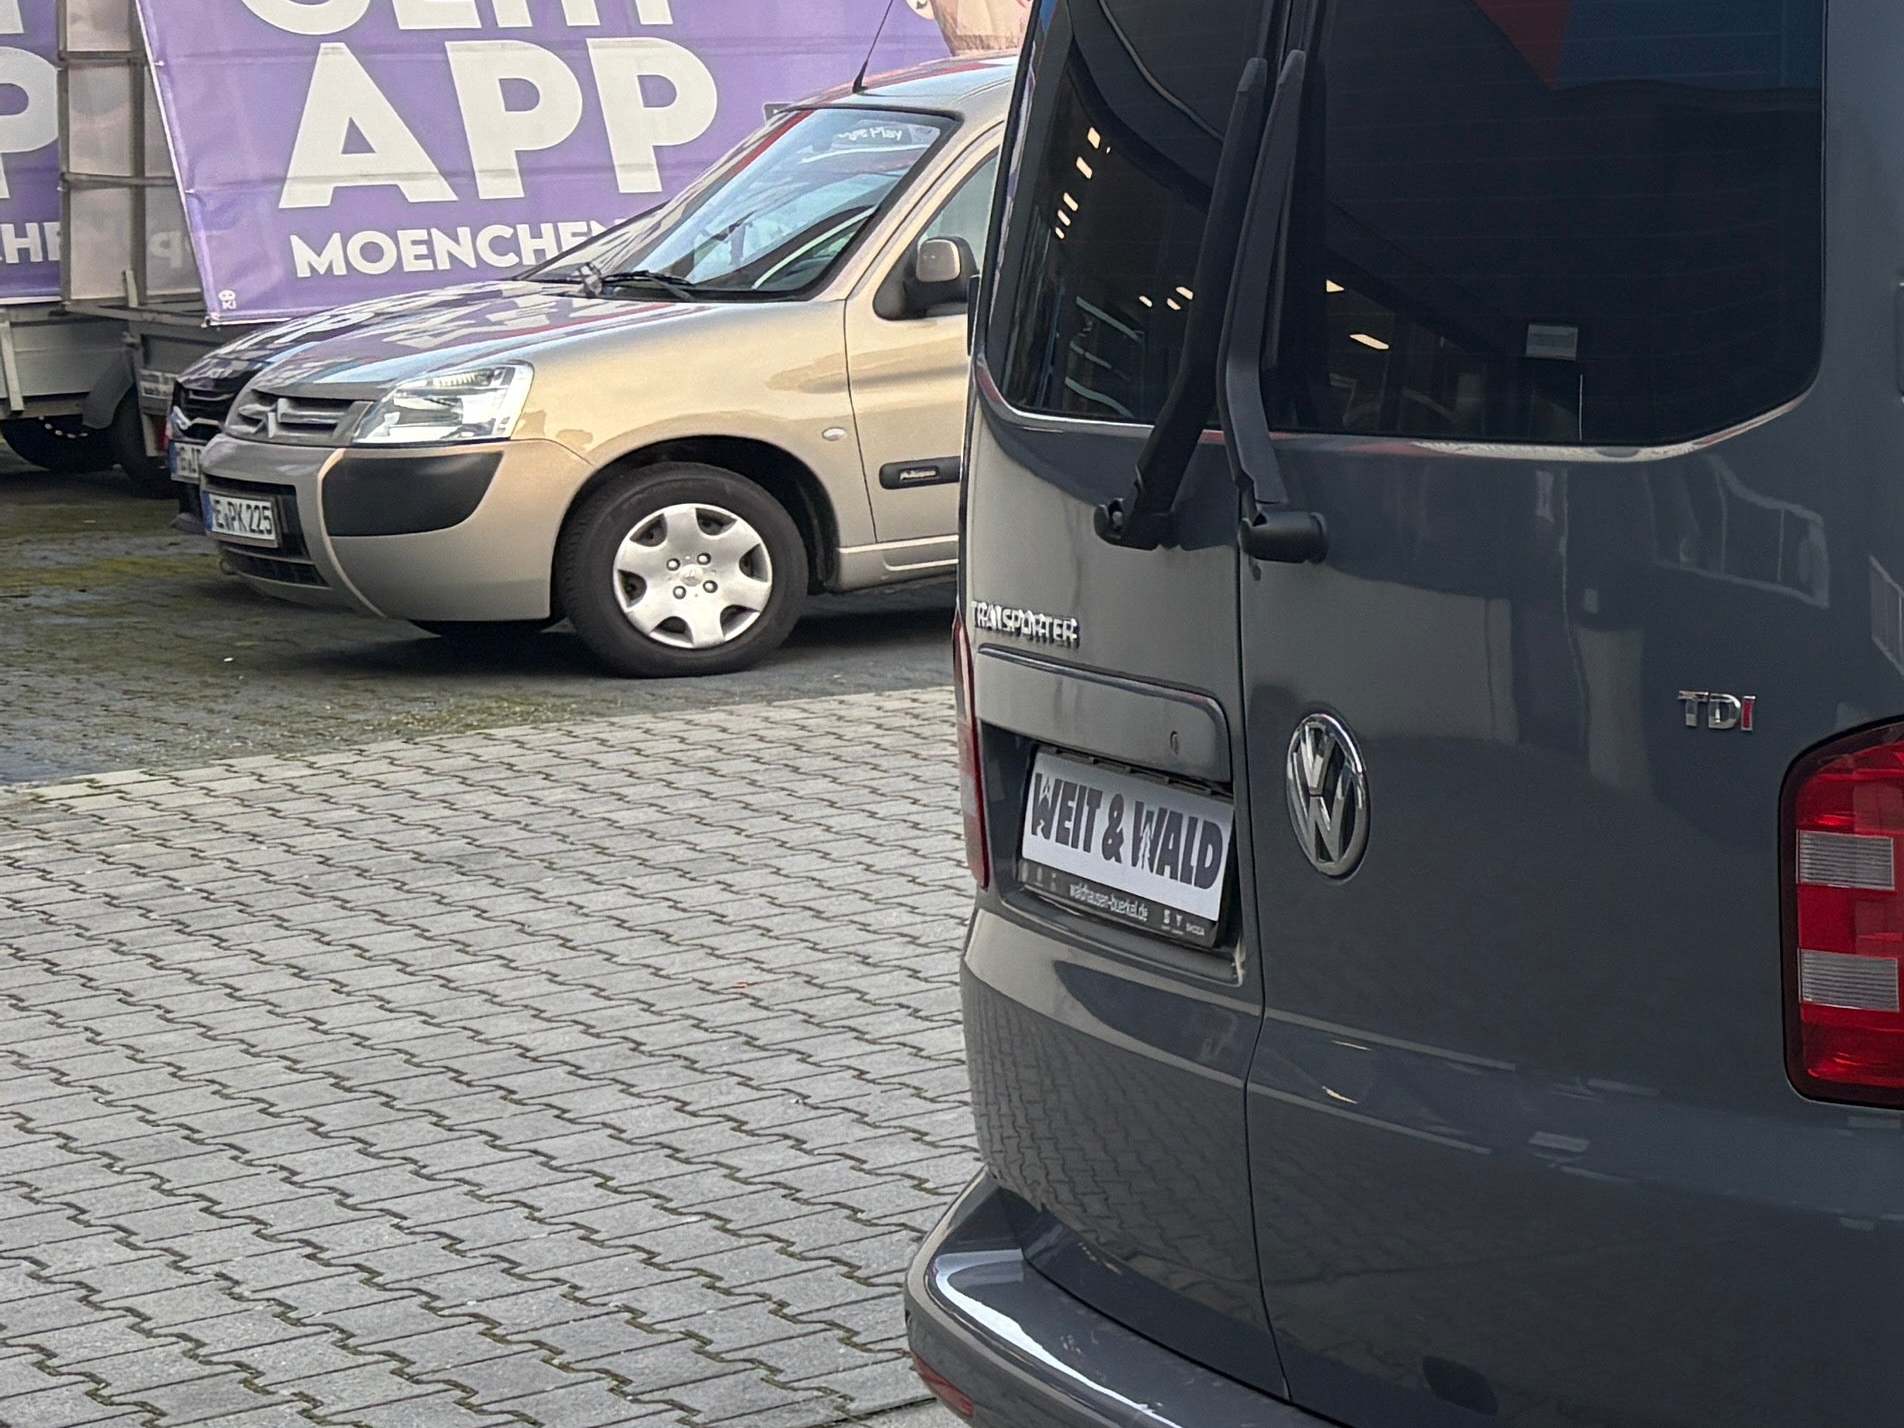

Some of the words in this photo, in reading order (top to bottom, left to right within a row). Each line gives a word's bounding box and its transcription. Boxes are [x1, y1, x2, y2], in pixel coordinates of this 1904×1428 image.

[277, 35, 719, 211] APP
[1677, 690, 1757, 732] TDI
[1031, 773, 1104, 854] WEIT
[1101, 793, 1125, 865] &
[1131, 800, 1223, 890] WALD
